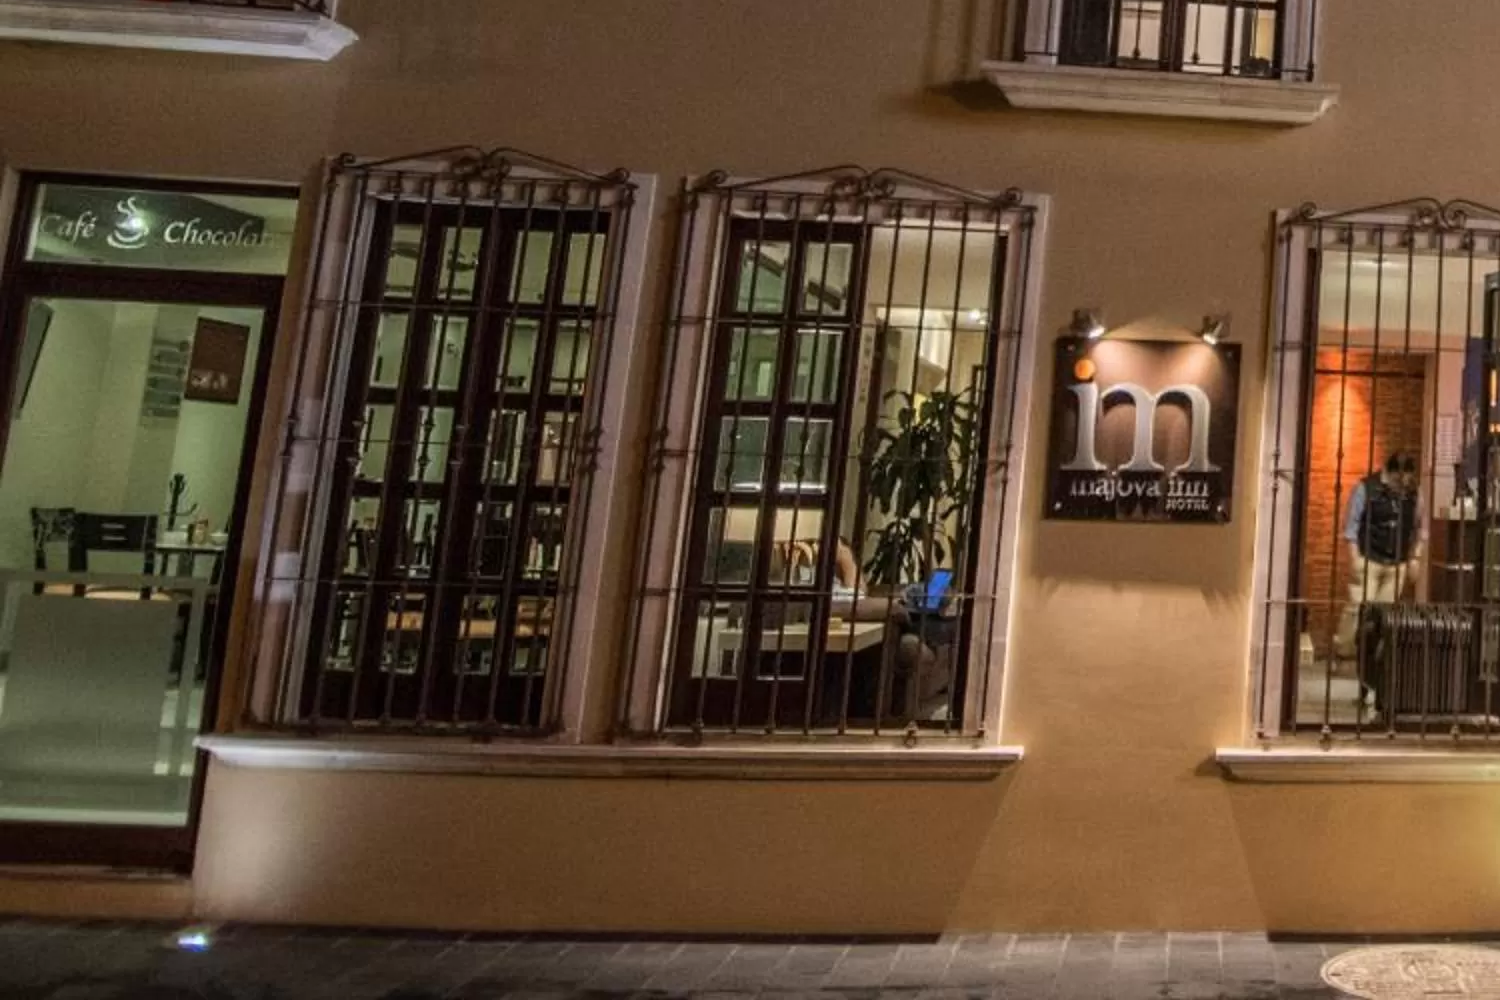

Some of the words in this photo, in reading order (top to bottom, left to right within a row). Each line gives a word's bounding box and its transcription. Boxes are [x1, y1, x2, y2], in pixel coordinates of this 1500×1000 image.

[40, 210, 98, 246] Café
[1070, 471, 1161, 502] majova
[1167, 471, 1210, 498] inn
[1165, 498, 1210, 512] HOTEL
